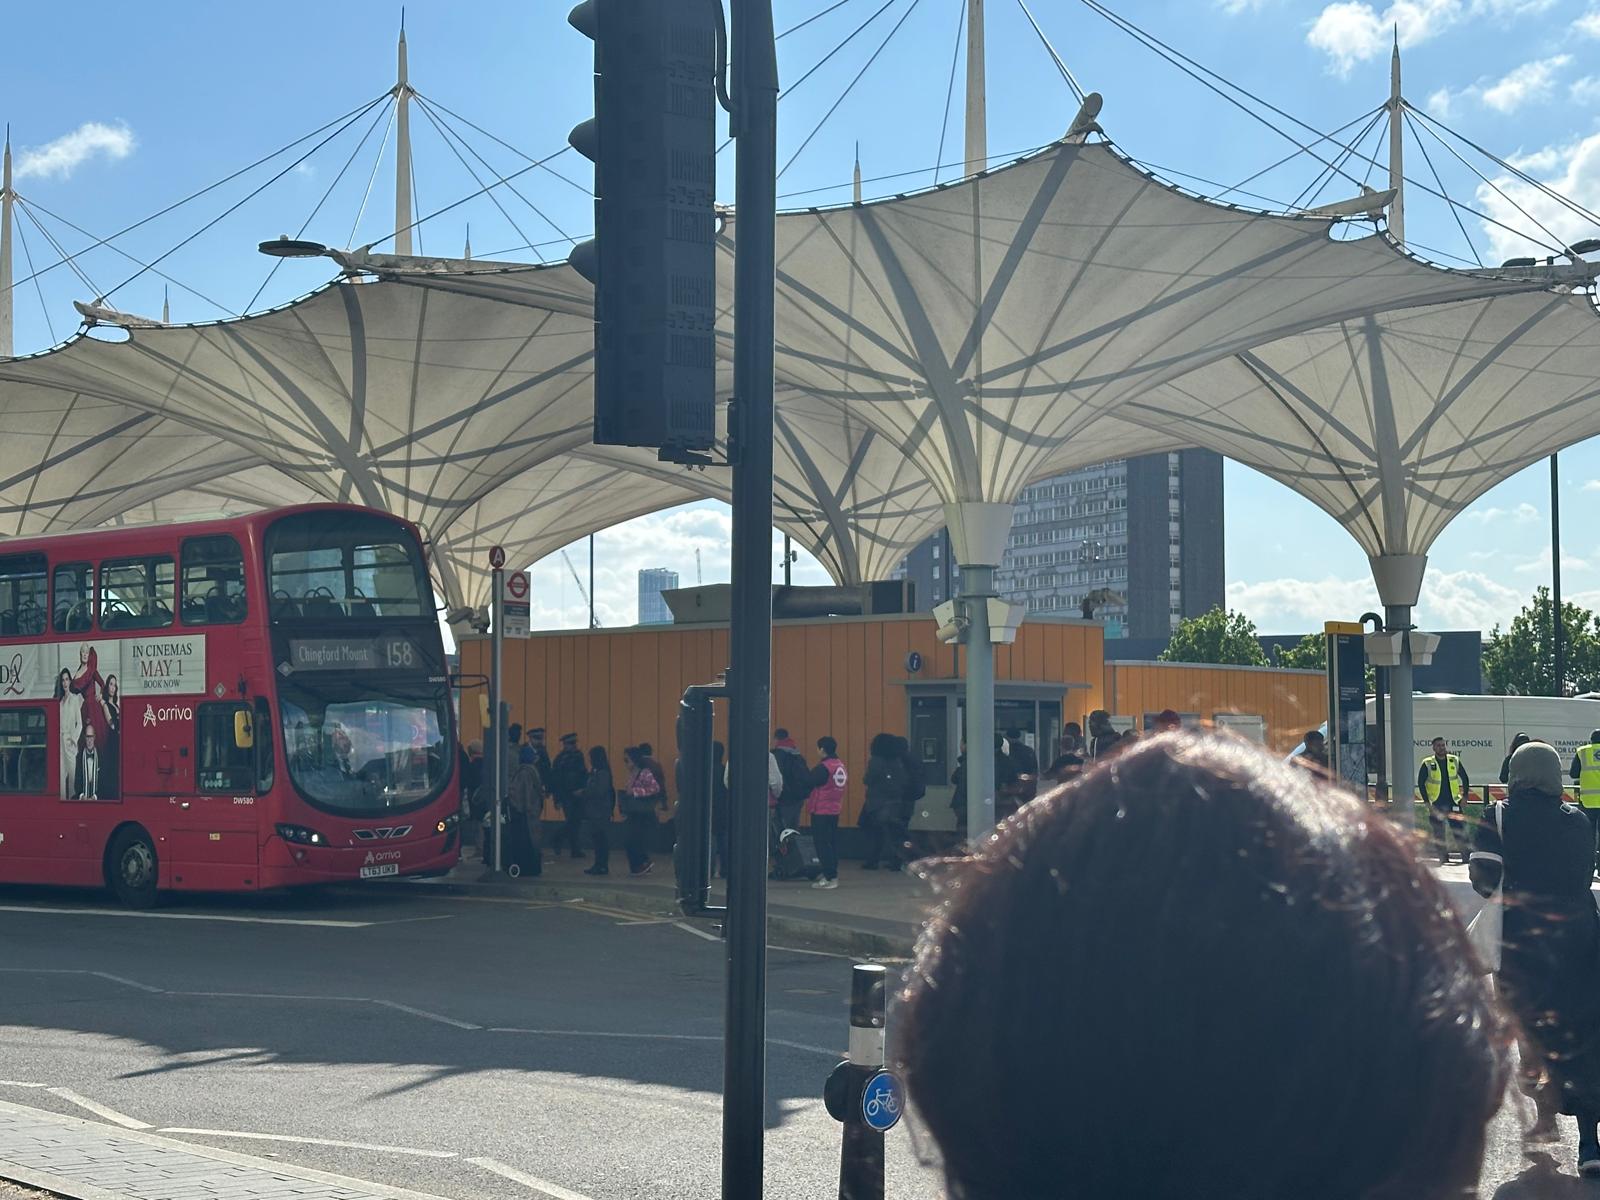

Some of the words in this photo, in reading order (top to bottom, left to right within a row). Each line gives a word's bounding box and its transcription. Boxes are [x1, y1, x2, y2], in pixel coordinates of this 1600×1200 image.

[492, 548, 503, 563] A
[132, 645, 144, 658] IN
[145, 643, 192, 657] CINEMAS
[299, 646, 340, 665] Chingford
[342, 647, 369, 661] Mount
[387, 642, 413, 666] 158
[140, 660, 173, 678] MAY
[177, 661, 184, 676] 1
[143, 680, 162, 689] BOOK
[163, 679, 180, 688] NOW
[157, 704, 192, 721] arriva
[233, 797, 254, 805] DW580
[375, 850, 401, 860] arriva
